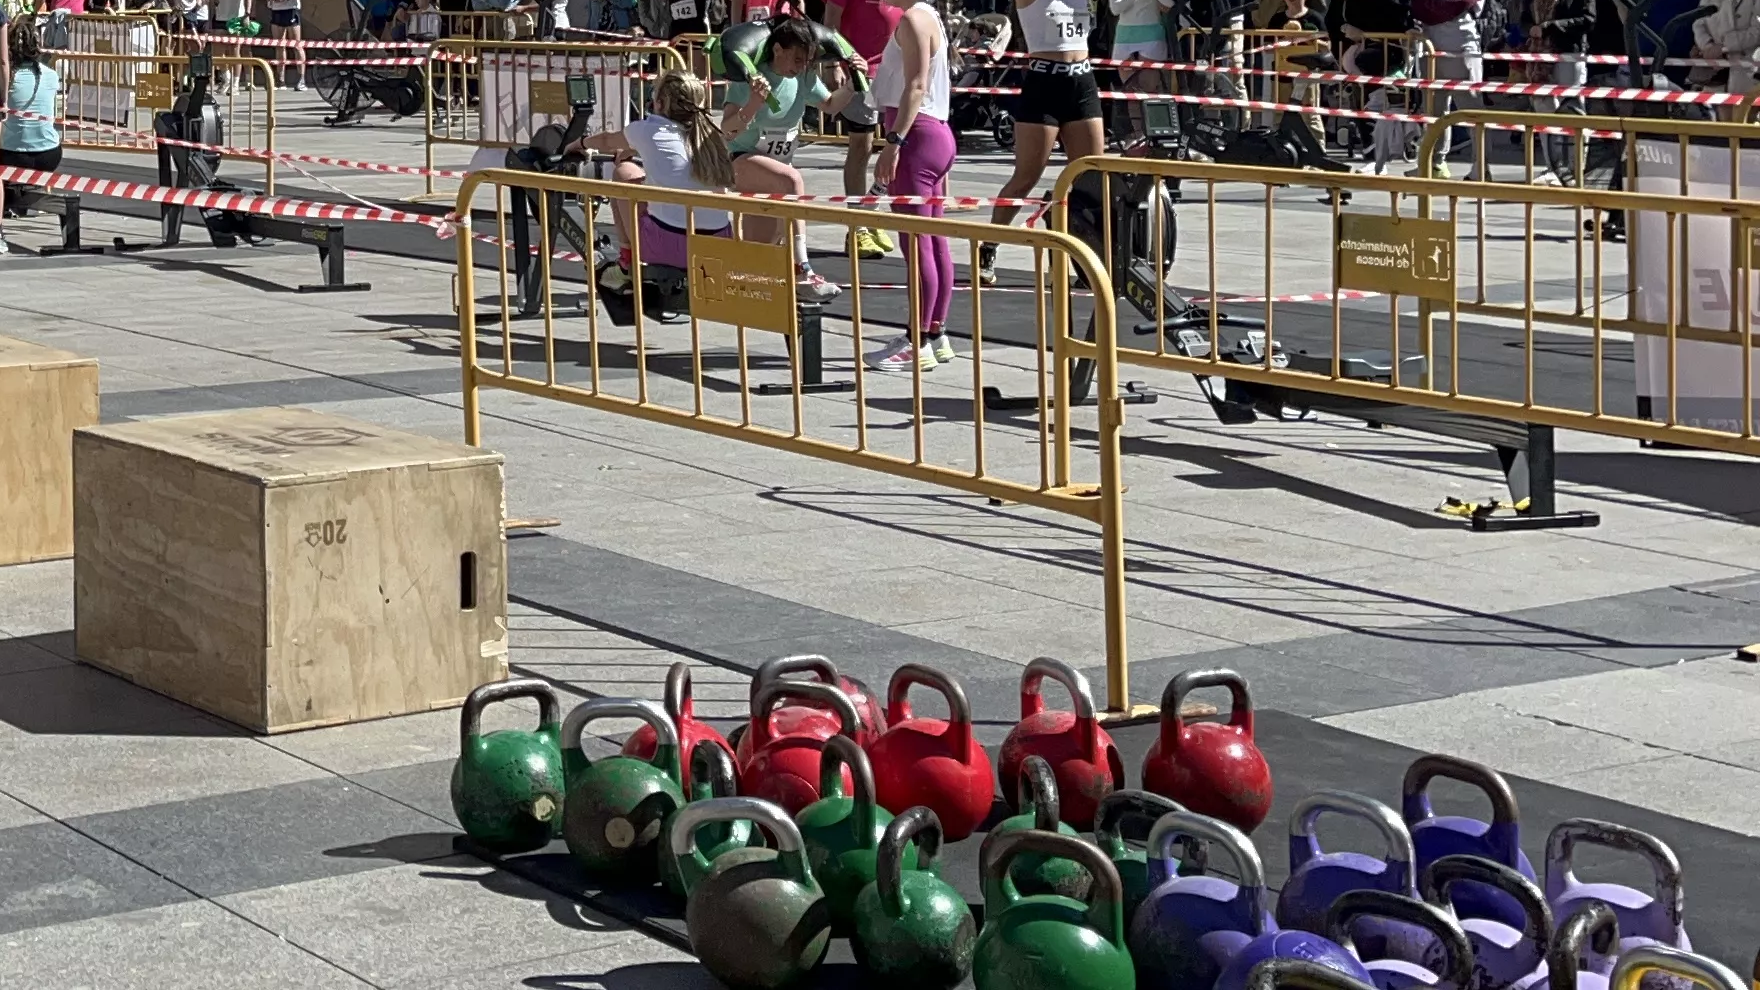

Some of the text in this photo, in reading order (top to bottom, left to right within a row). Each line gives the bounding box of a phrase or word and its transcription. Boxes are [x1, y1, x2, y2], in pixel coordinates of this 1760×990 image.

[1056, 22, 1084, 38] 154
[1051, 59, 1091, 77] PRO
[766, 140, 792, 156] 153
[322, 518, 348, 546] 20
